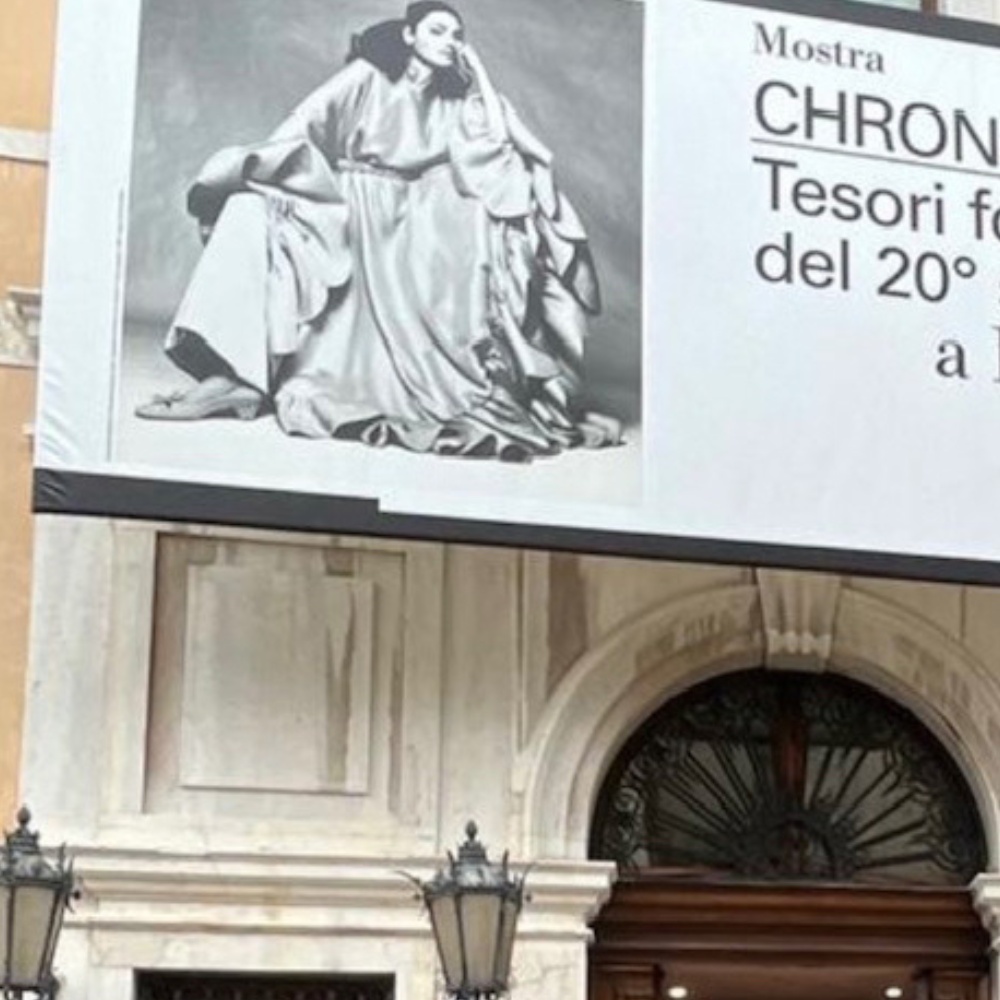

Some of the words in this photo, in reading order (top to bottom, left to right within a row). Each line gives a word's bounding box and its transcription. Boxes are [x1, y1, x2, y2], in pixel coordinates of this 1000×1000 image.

[754, 21, 885, 74] Mostra
[751, 155, 944, 236] Tesori
[754, 230, 851, 292] del
[876, 245, 978, 304] 20°
[934, 339, 969, 380] a
